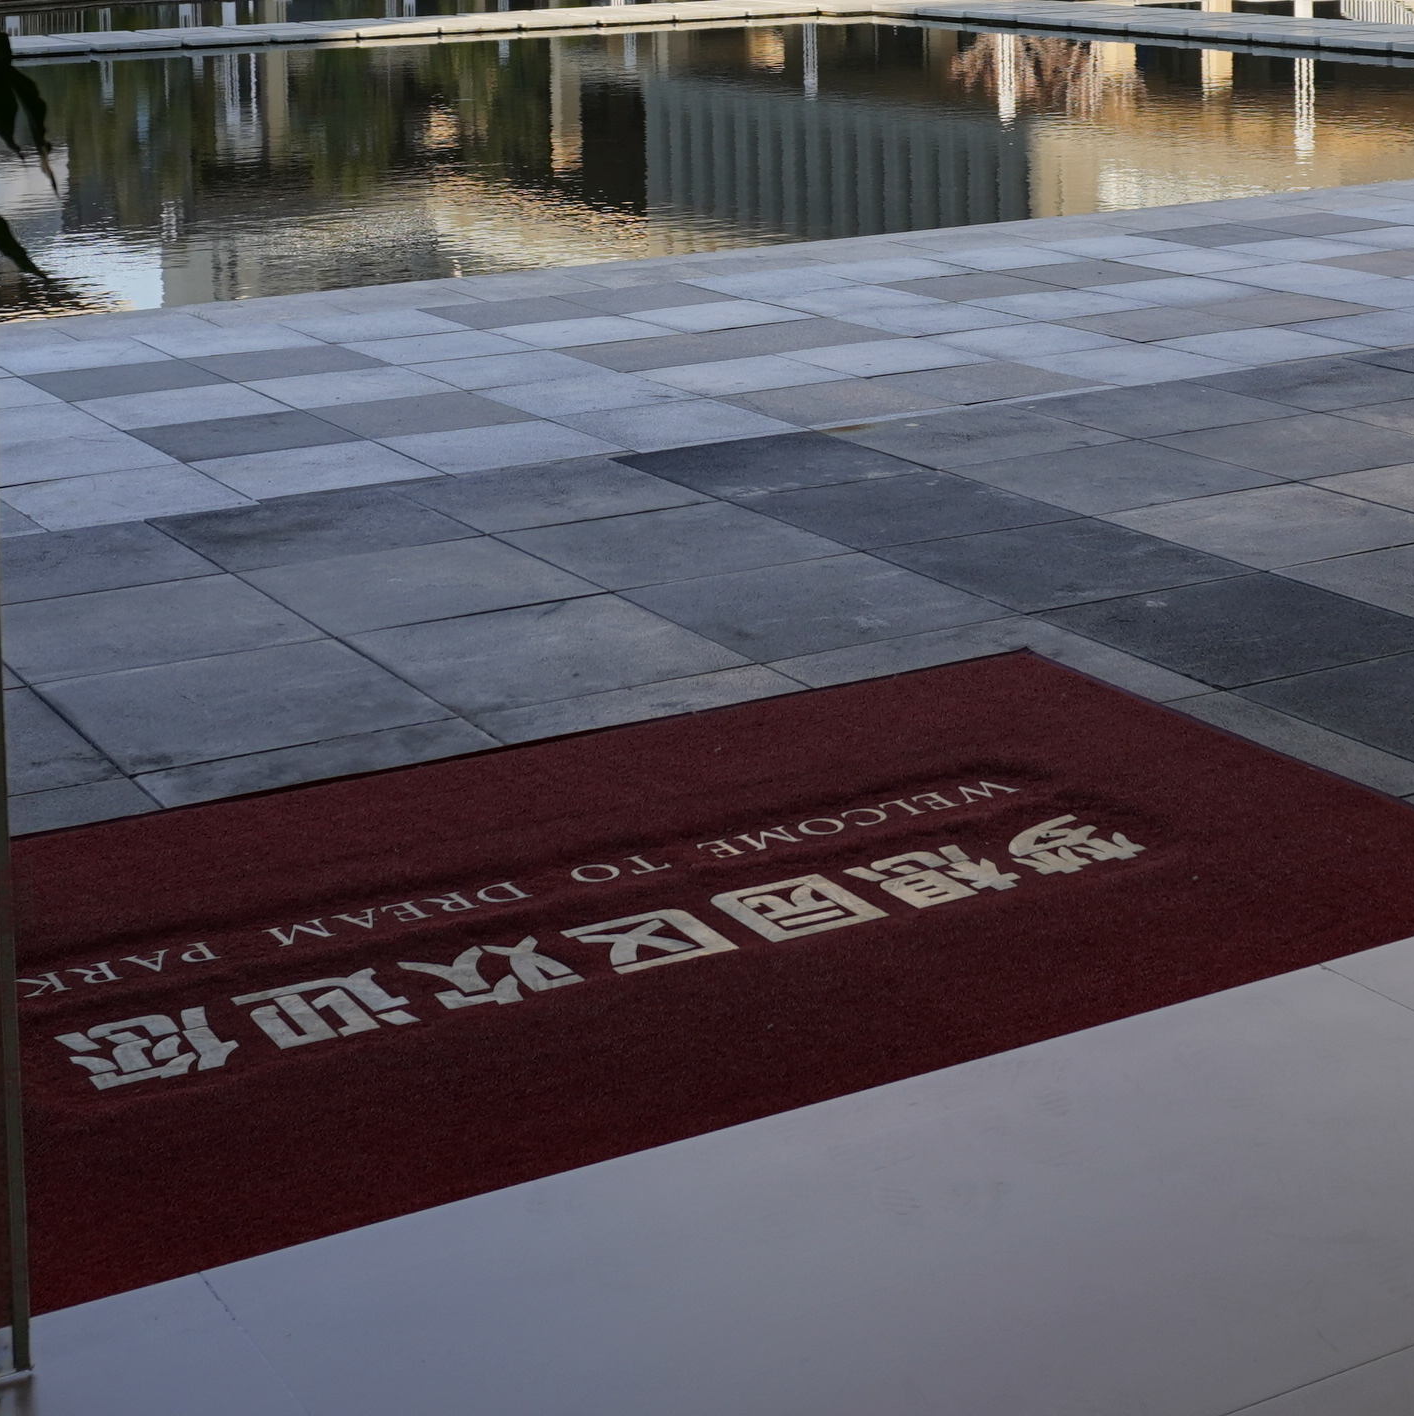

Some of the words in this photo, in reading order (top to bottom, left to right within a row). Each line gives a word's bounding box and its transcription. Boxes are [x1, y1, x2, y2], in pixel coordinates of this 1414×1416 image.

[697, 780, 1020, 859] WELCOME
[570, 855, 674, 883] TO
[265, 881, 533, 947] DREAM
[15, 941, 222, 998] PARK
[54, 813, 1146, 1091] 梦想园区欢迎您
